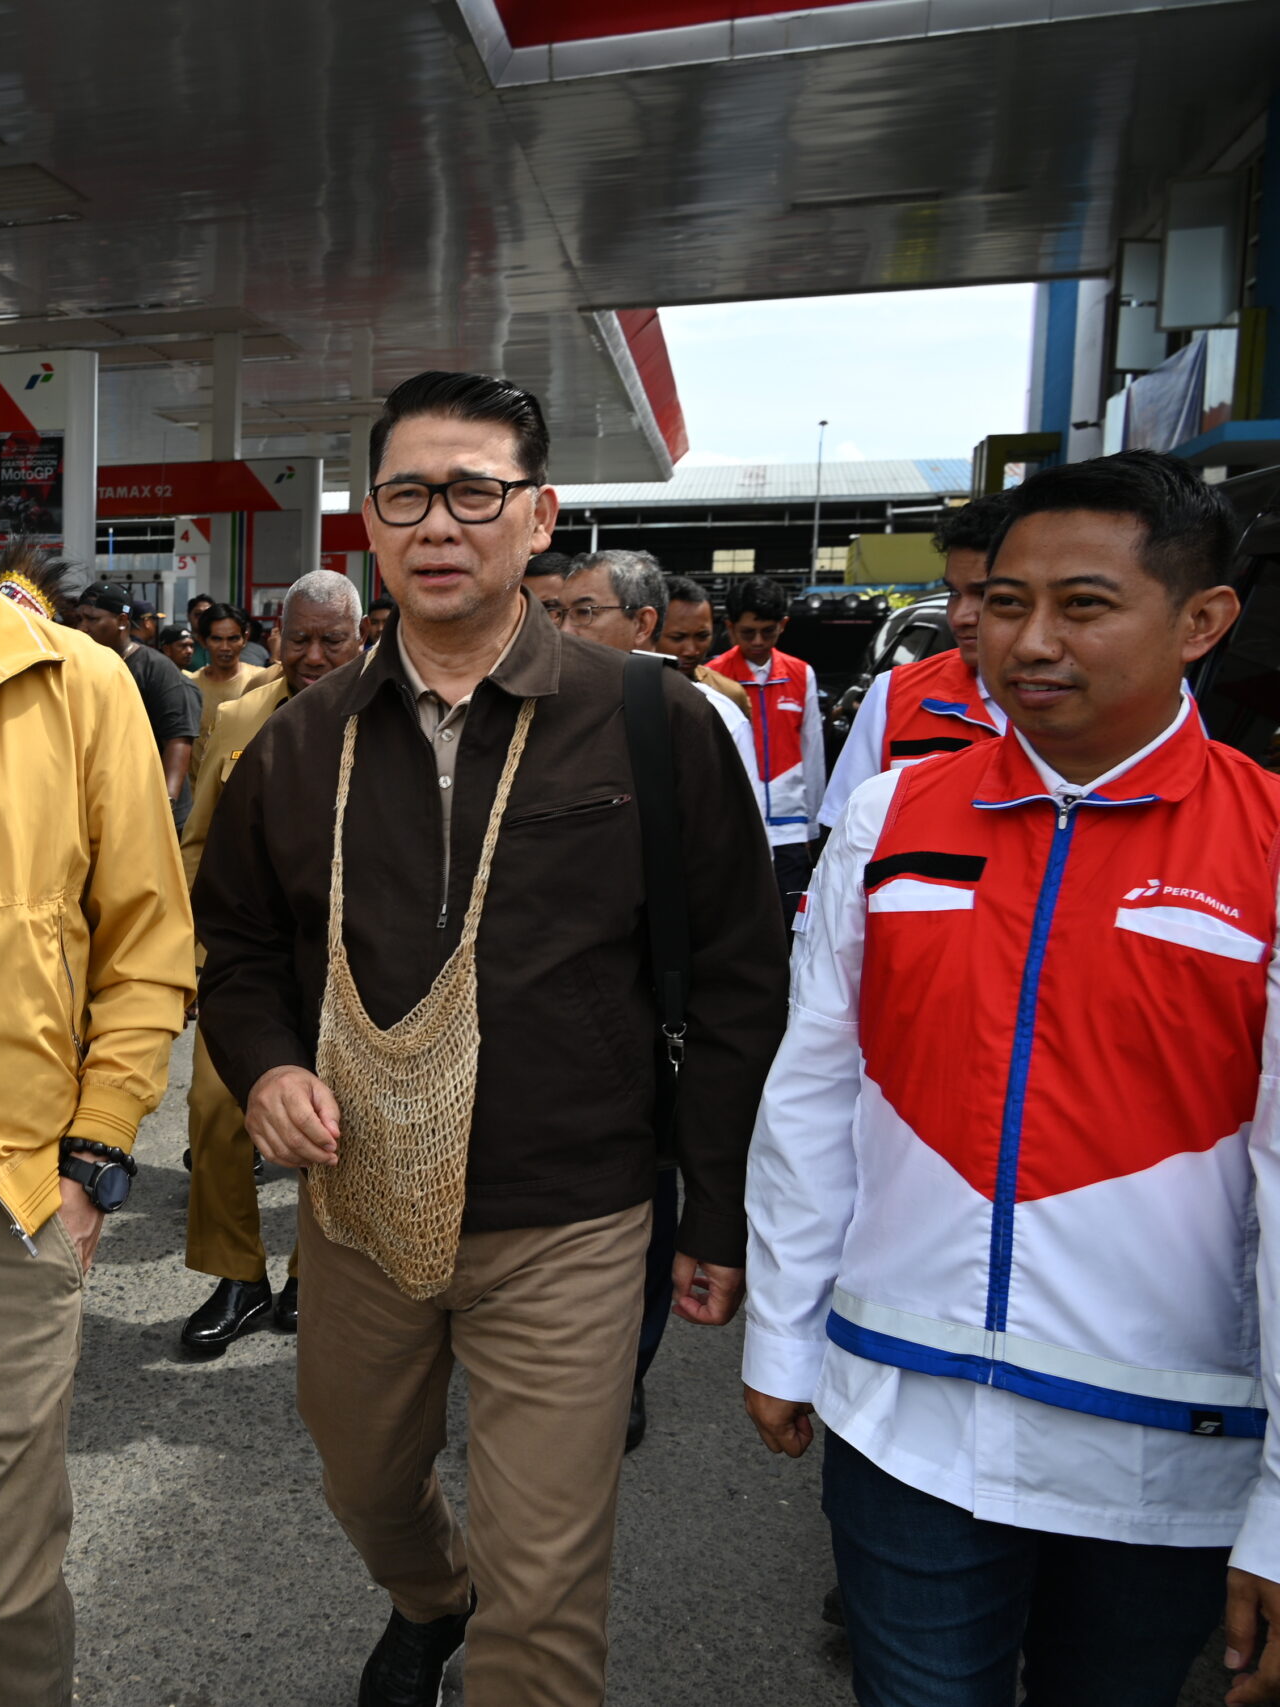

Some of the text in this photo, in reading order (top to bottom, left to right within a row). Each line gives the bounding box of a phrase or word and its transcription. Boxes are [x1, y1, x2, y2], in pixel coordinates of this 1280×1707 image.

[0, 466, 54, 480] MotoGP
[155, 485, 173, 497] 92
[180, 529, 190, 543] 4
[177, 556, 188, 570] 5
[1162, 885, 1241, 919] PERTAMINA
